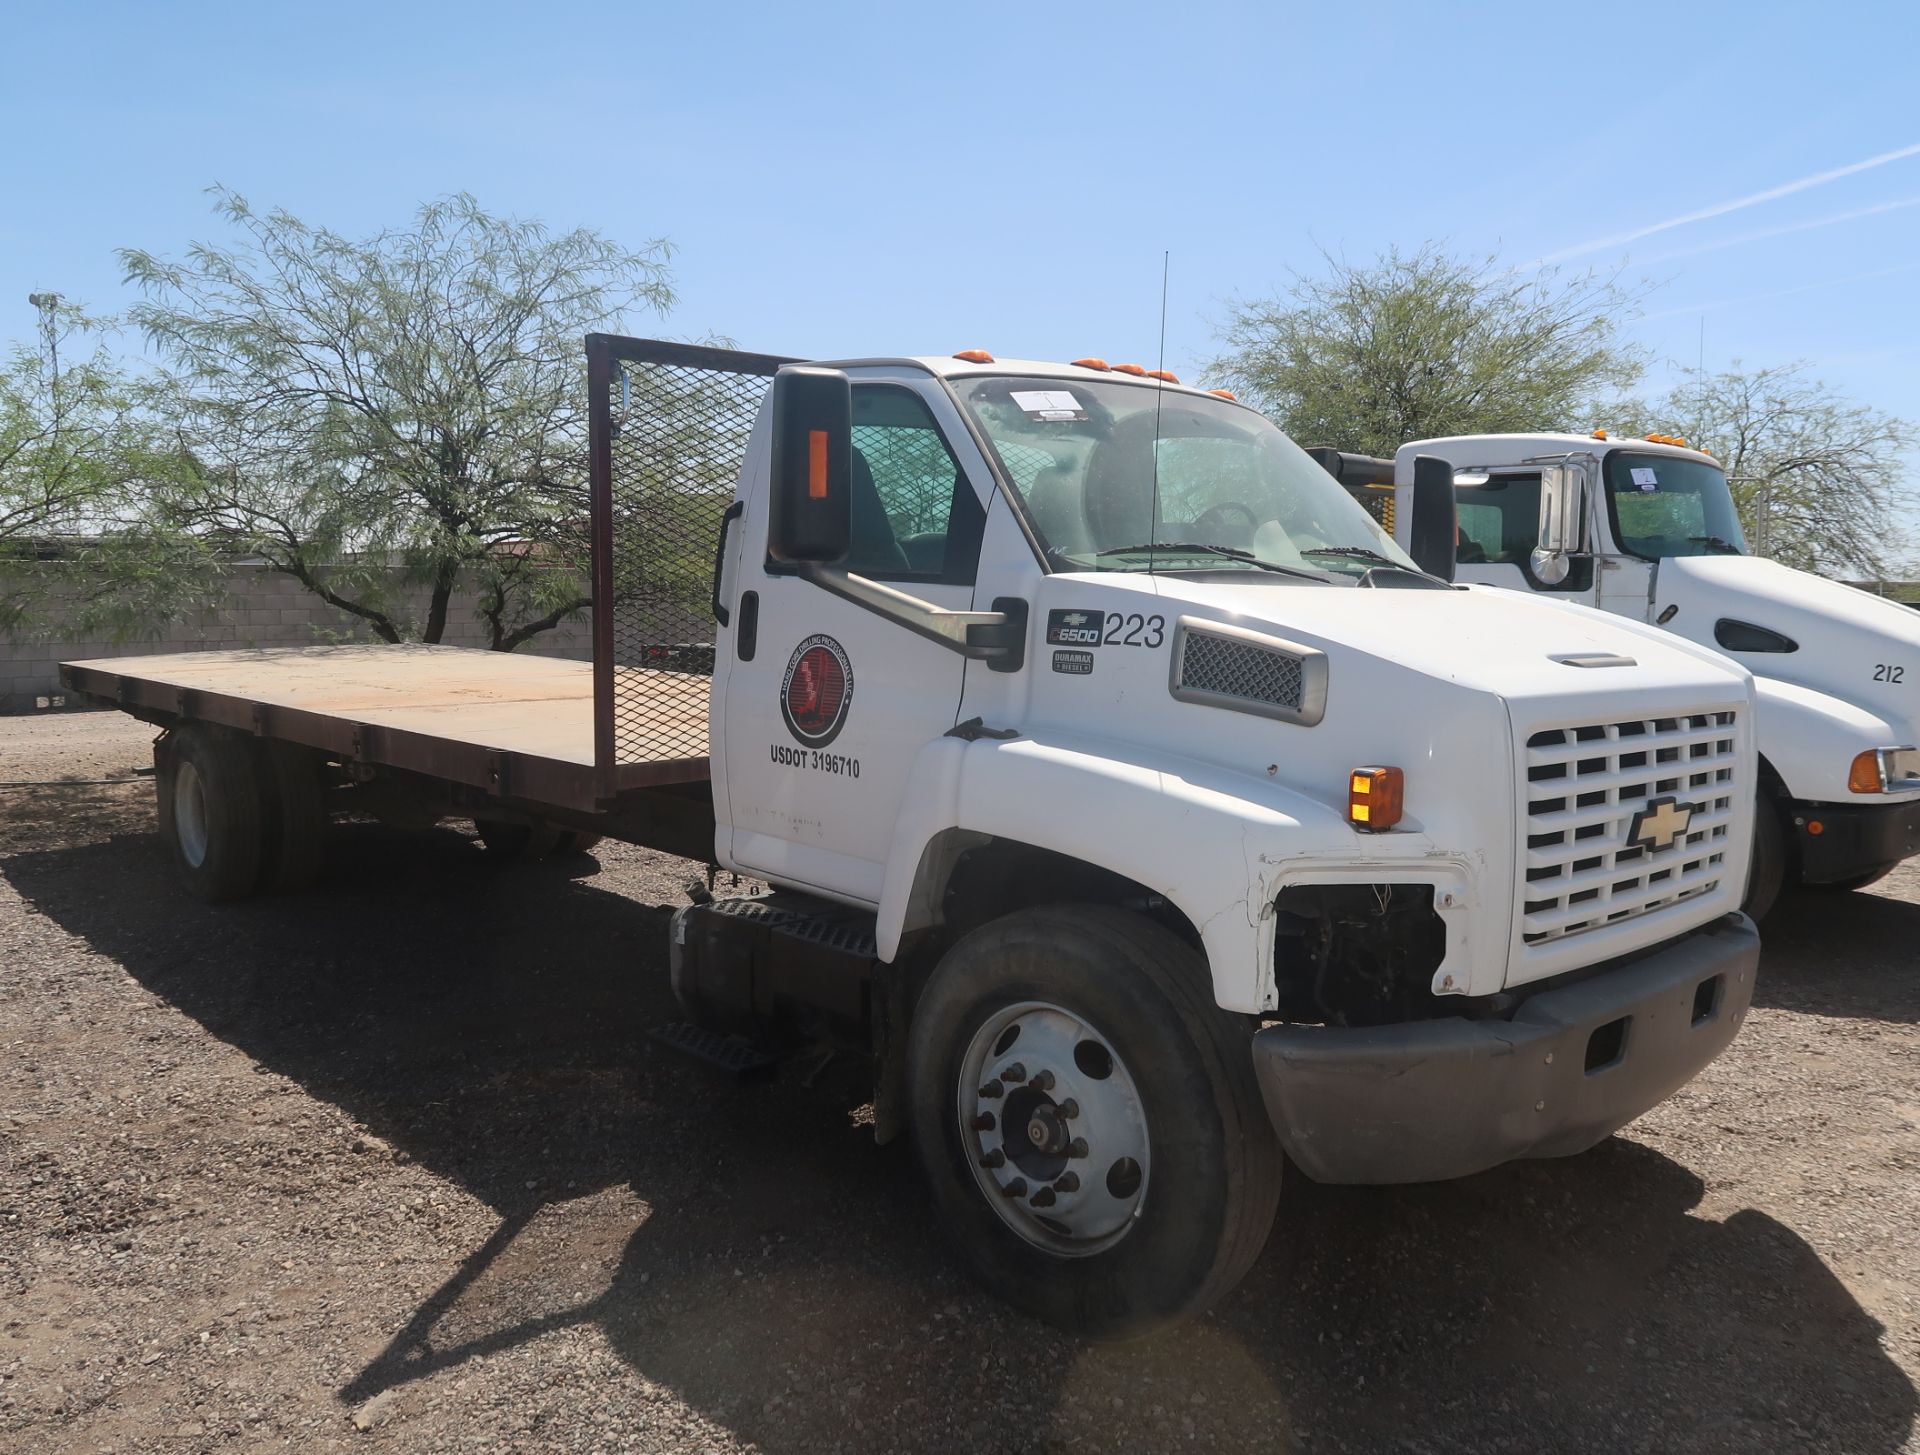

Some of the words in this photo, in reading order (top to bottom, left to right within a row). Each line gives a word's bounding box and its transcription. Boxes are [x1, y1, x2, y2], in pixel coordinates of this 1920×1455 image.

[1049, 627, 1099, 643] C6500
[1103, 613, 1165, 648] 223
[782, 668, 792, 691] HARD
[789, 651, 802, 669] CORE
[798, 635, 821, 653] DRILLING
[821, 635, 853, 681] PROFESSIONALS
[1054, 652, 1092, 664] DURAMAX
[1873, 664, 1904, 684] 212
[770, 744, 808, 769] USDOT
[811, 750, 860, 778] 3196710
